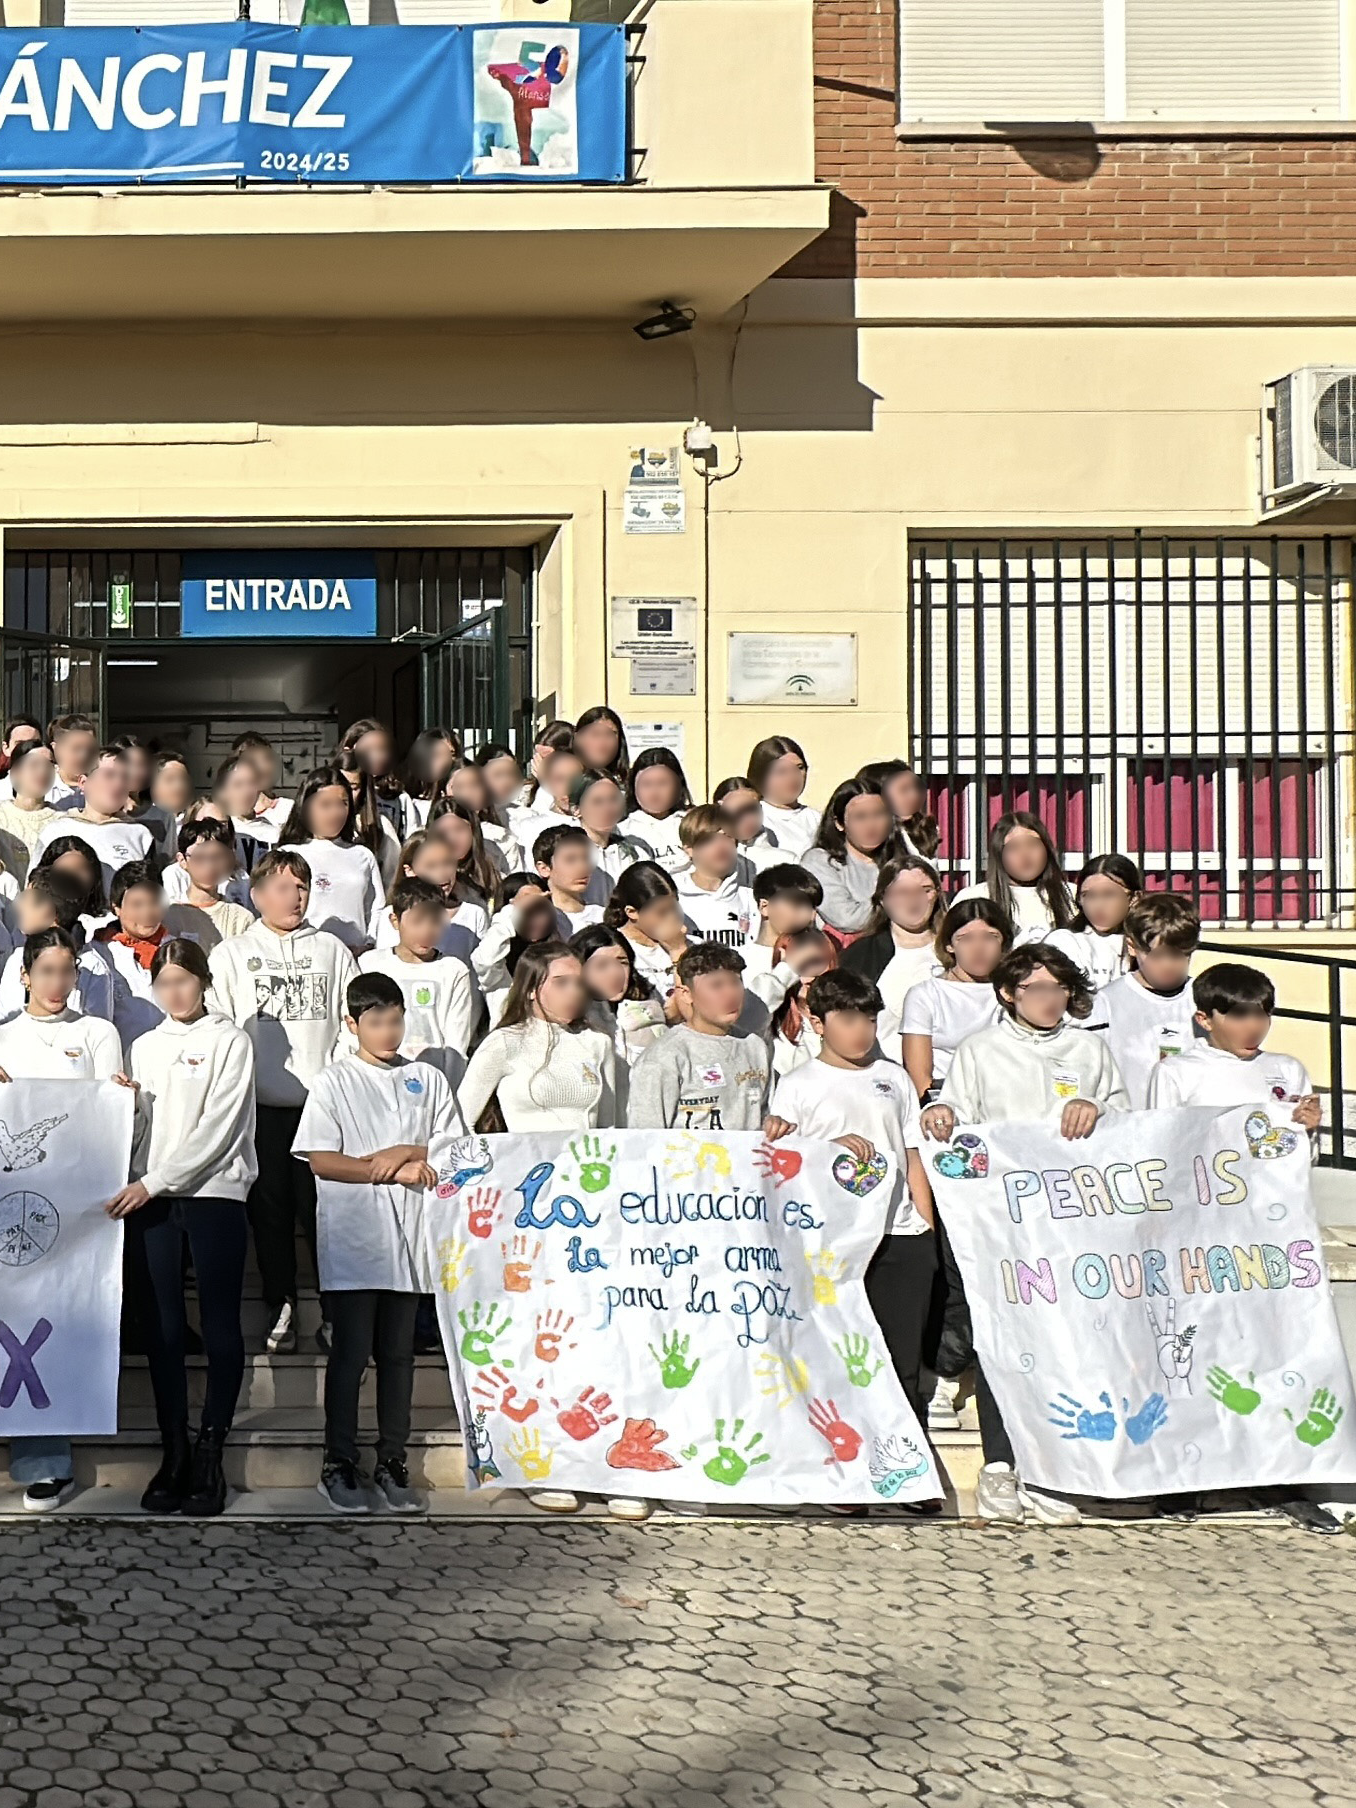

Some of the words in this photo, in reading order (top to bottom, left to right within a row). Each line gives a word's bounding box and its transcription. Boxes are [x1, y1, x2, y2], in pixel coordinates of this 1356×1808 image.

[260, 149, 351, 173] 2024/25
[205, 578, 352, 612] ENTRADA
[514, 1162, 602, 1230] La
[783, 1200, 825, 1231] es
[1002, 1158, 1173, 1224] PEACE
[1193, 1149, 1248, 1206] IS
[630, 1242, 700, 1279] mejor
[724, 1246, 783, 1272] arma
[1000, 1258, 1058, 1305] IN
[1071, 1249, 1170, 1300] OUR
[1179, 1239, 1322, 1295] HANDS
[601, 1285, 669, 1327] para
